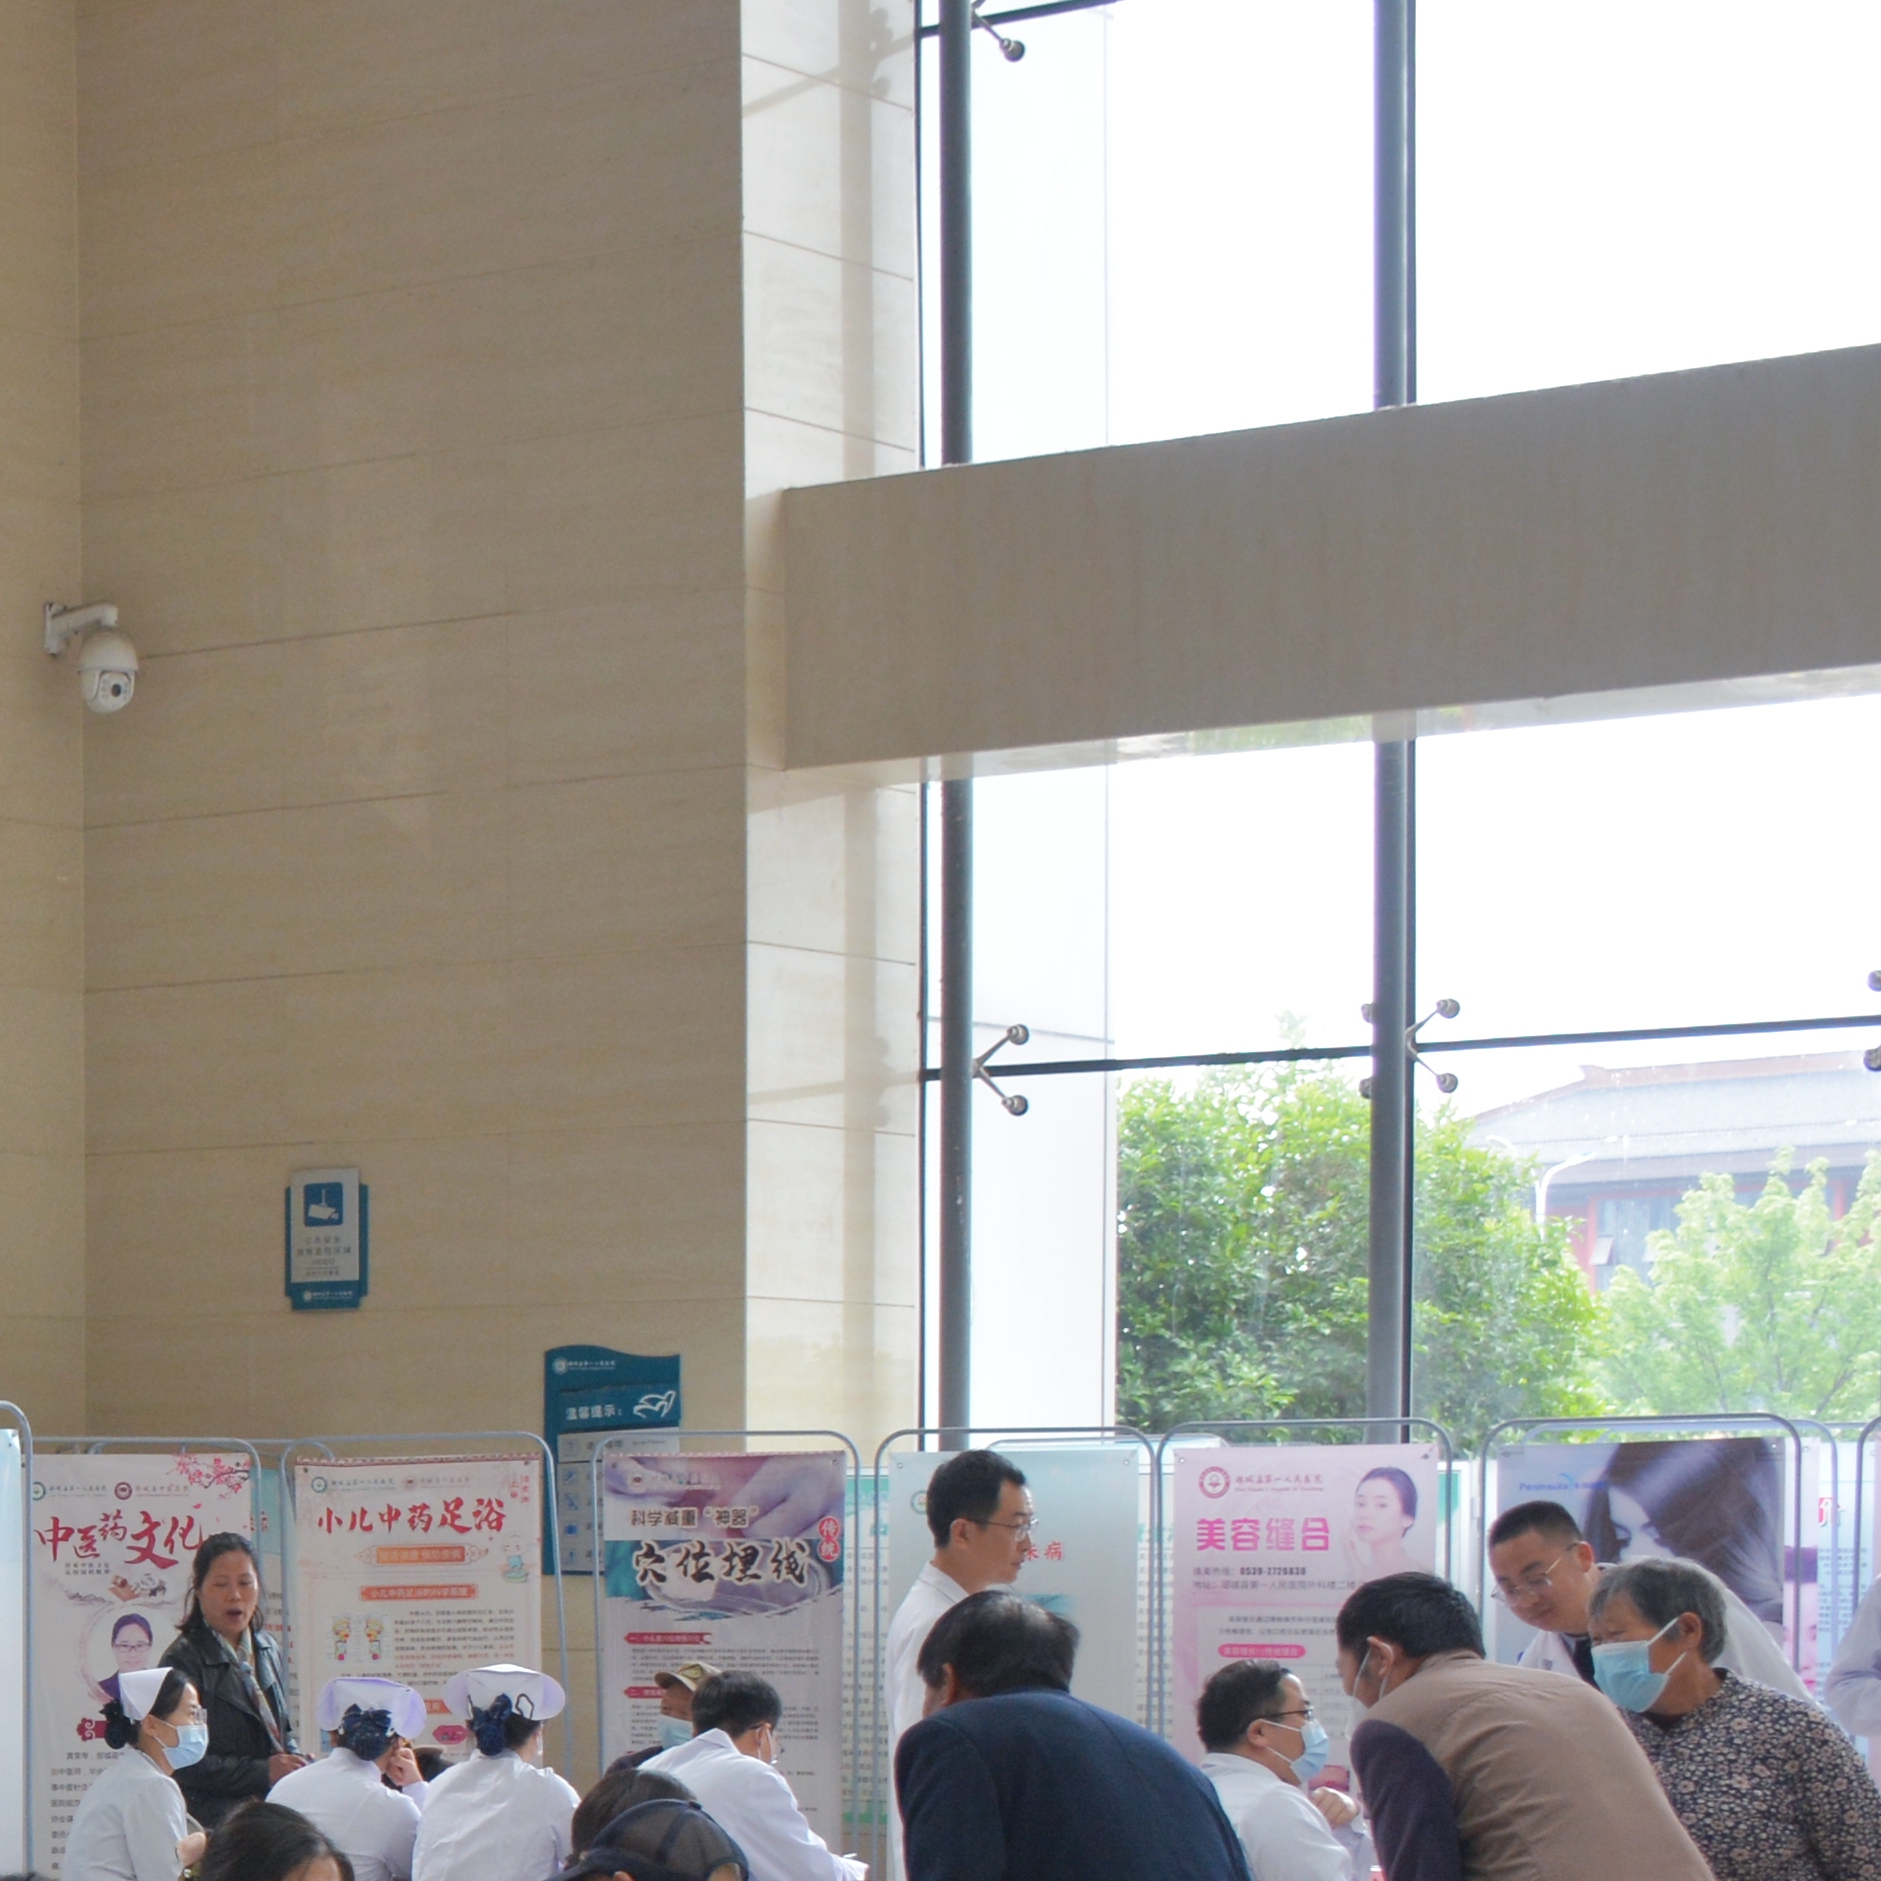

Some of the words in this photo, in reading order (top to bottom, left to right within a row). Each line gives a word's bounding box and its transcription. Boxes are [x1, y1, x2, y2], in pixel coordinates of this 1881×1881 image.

[318, 1496, 506, 1535] 小儿中药足浴
[1197, 1517, 1330, 1551] 美容缝合
[34, 1509, 207, 1570] 中医药文化
[820, 1517, 838, 1560] 传统
[633, 1539, 808, 1586] 穴位埋线
